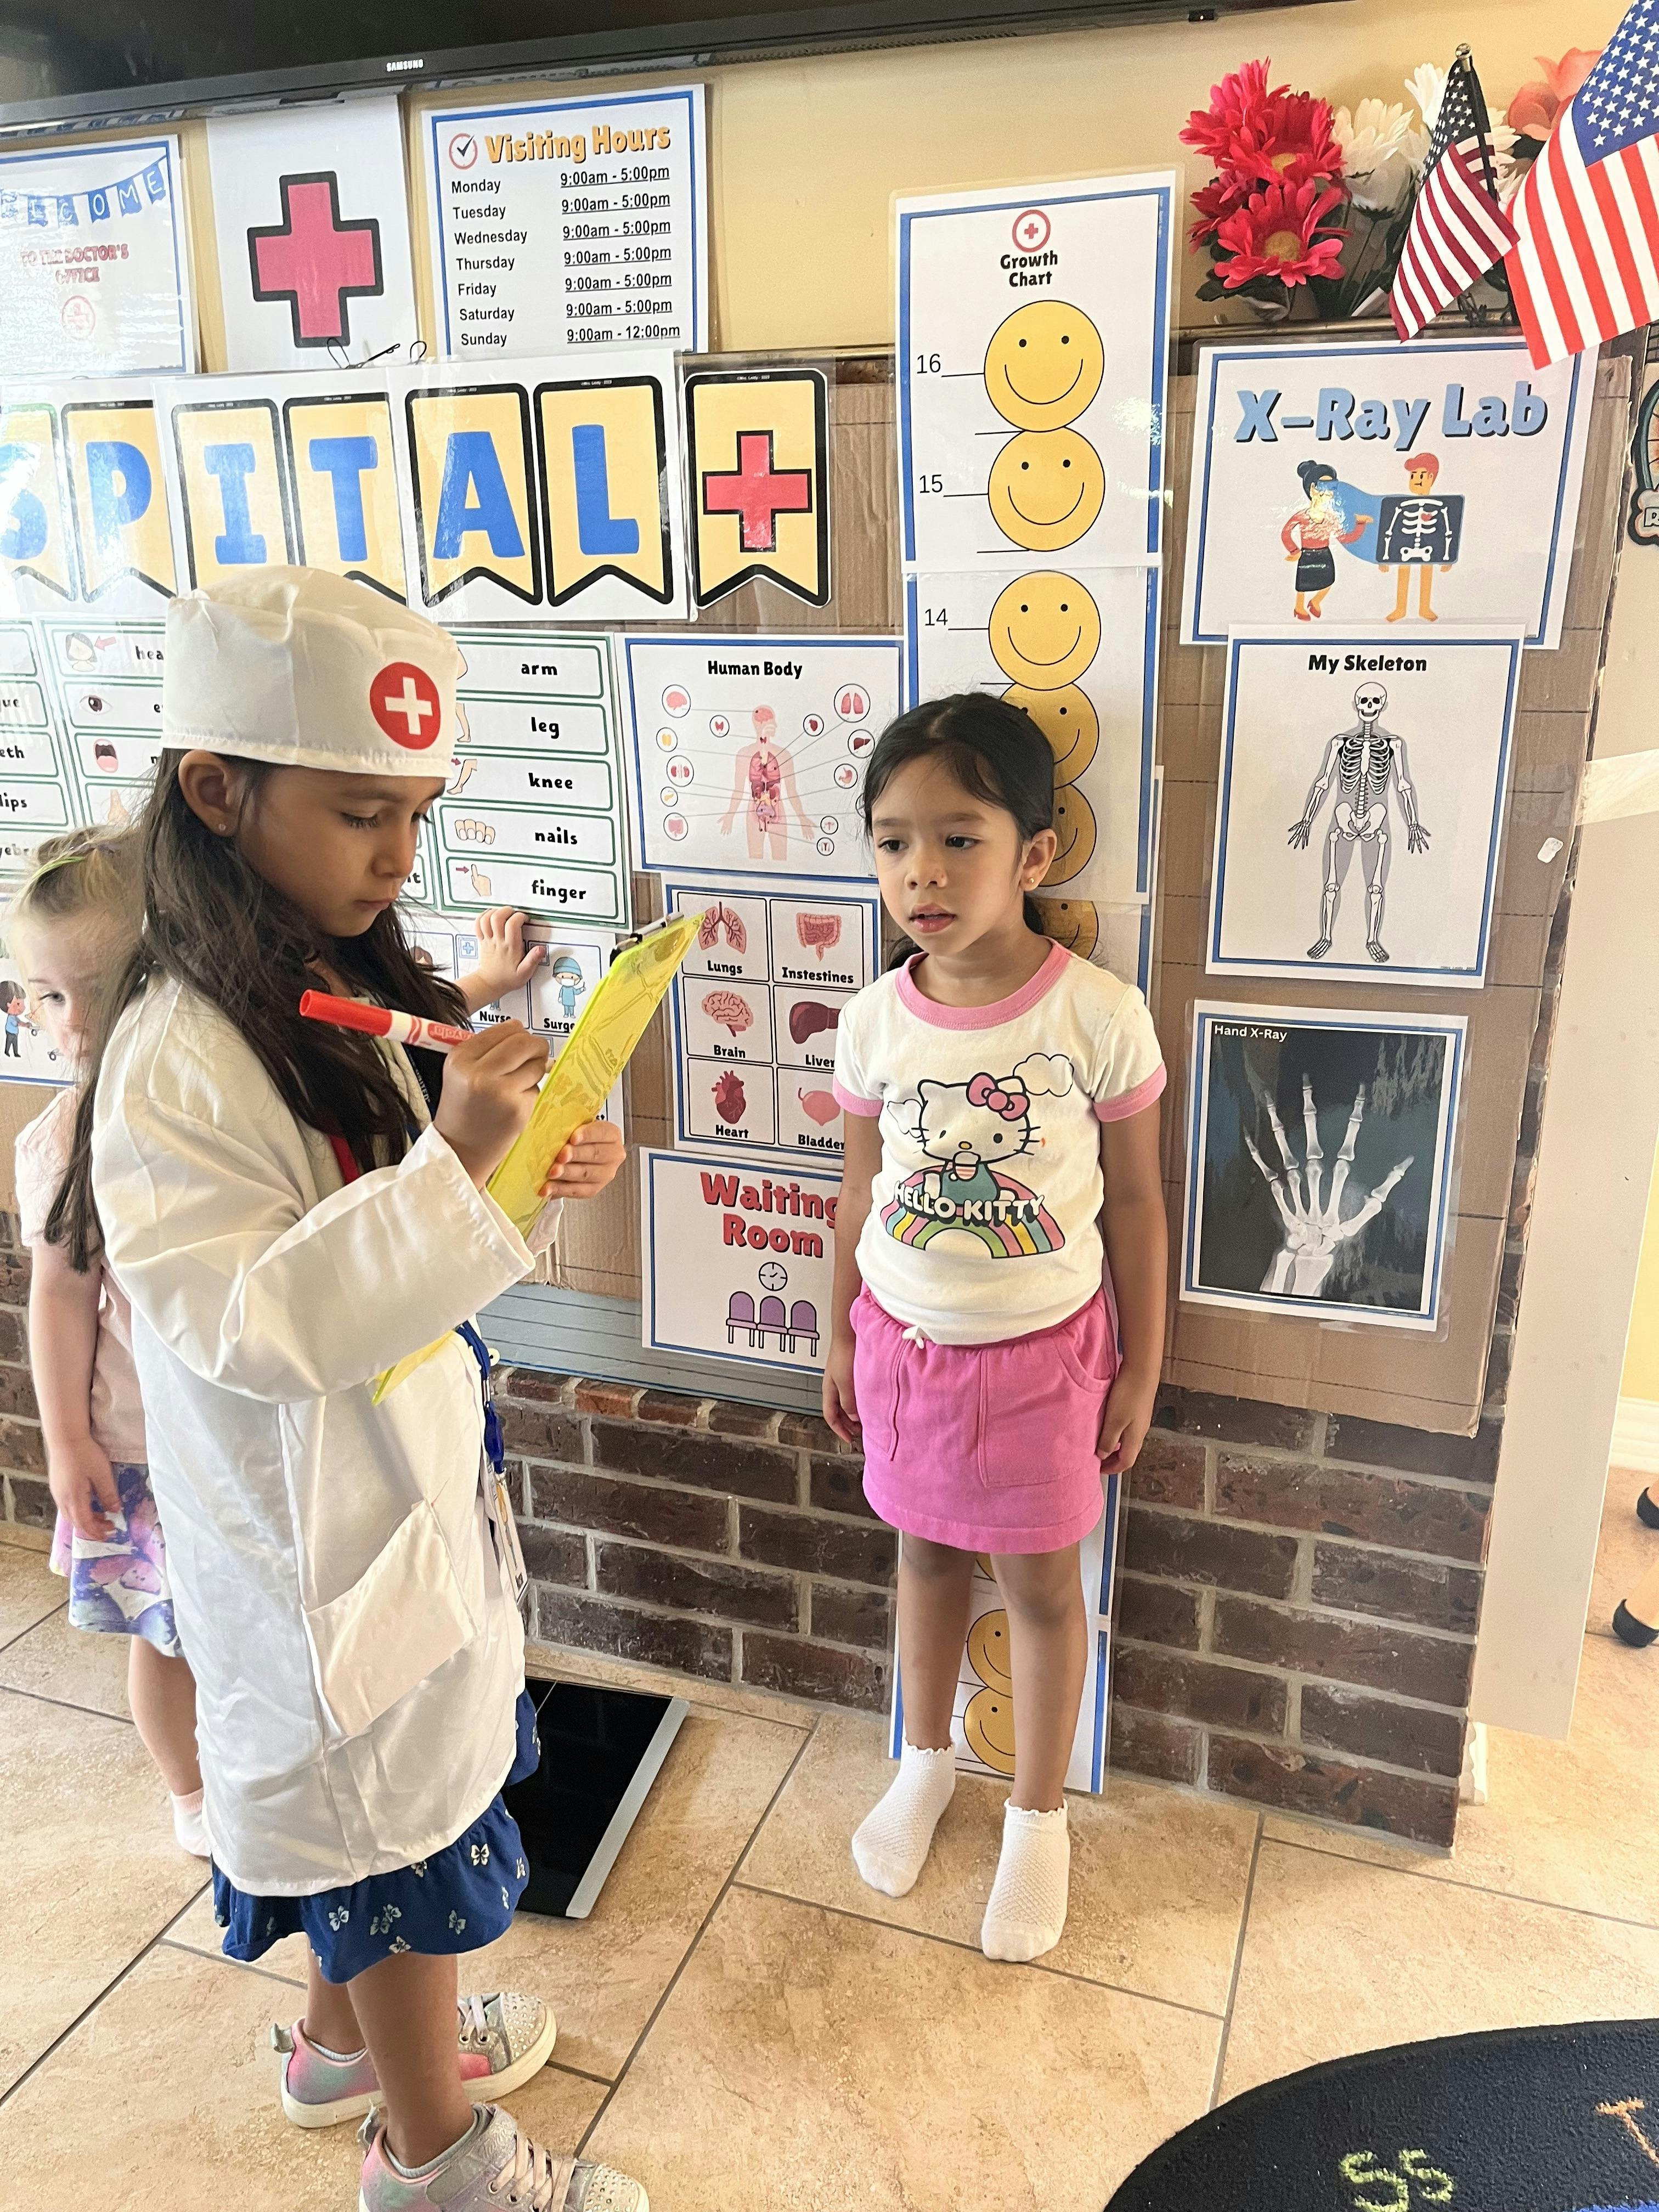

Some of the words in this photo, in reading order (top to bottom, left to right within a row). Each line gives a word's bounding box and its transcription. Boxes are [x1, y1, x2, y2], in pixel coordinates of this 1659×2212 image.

[387, 59, 423, 71] SAMSUNG
[484, 131, 586, 163] Visiting
[592, 125, 671, 153] Hours
[452, 179, 501, 195] Monday
[560, 171, 608, 187] 9:00am
[620, 166, 670, 183] 5:00pm
[453, 205, 506, 221] Tuesday
[562, 198, 609, 213] 9:00am
[622, 193, 670, 209] 5:00pm
[454, 229, 528, 245] Wednesday
[563, 225, 610, 240] 9:00am
[623, 219, 671, 235] 5:00pm
[456, 256, 515, 271] Thursday
[564, 251, 611, 266] 9:00am
[624, 247, 672, 262] 5:00pm
[1000, 250, 1058, 269] Growth
[458, 283, 496, 297] Friday
[565, 277, 612, 291] 9:00am
[624, 273, 672, 289] 5:00pm
[1008, 271, 1052, 287] Chart
[460, 306, 515, 322] Saturday
[566, 303, 612, 318] 9:00am
[625, 299, 673, 315] 5:00pm
[461, 332, 507, 347] Sunday
[567, 329, 613, 343] 9:00am
[626, 324, 680, 340] 12:00pm
[916, 353, 941, 374] 16
[1233, 387, 1430, 452] X-Ray
[1442, 381, 1548, 437] Lab
[919, 474, 943, 493] 15
[924, 608, 948, 627] 14
[136, 645, 164, 660] hea
[521, 663, 558, 676] arm
[708, 661, 760, 676] Human
[764, 661, 803, 679] Body
[1308, 654, 1339, 674] My
[1344, 654, 1426, 672] Skeleton
[531, 716, 560, 739] leg
[528, 772, 573, 789] knee
[535, 827, 578, 845] nails
[532, 880, 586, 903] finger
[707, 960, 743, 975] Lungs
[782, 966, 854, 984] Instestines
[544, 1018, 575, 1033] Surge
[1214, 1025, 1248, 1039] Hand
[1250, 1028, 1288, 1042] X-Ray
[713, 1045, 746, 1059] Brain
[805, 1054, 834, 1068] Liver
[715, 1124, 749, 1138] Heart
[894, 1180, 957, 1220] HELLO
[962, 1194, 1045, 1223] KITTY
[723, 1213, 823, 1258] Room
